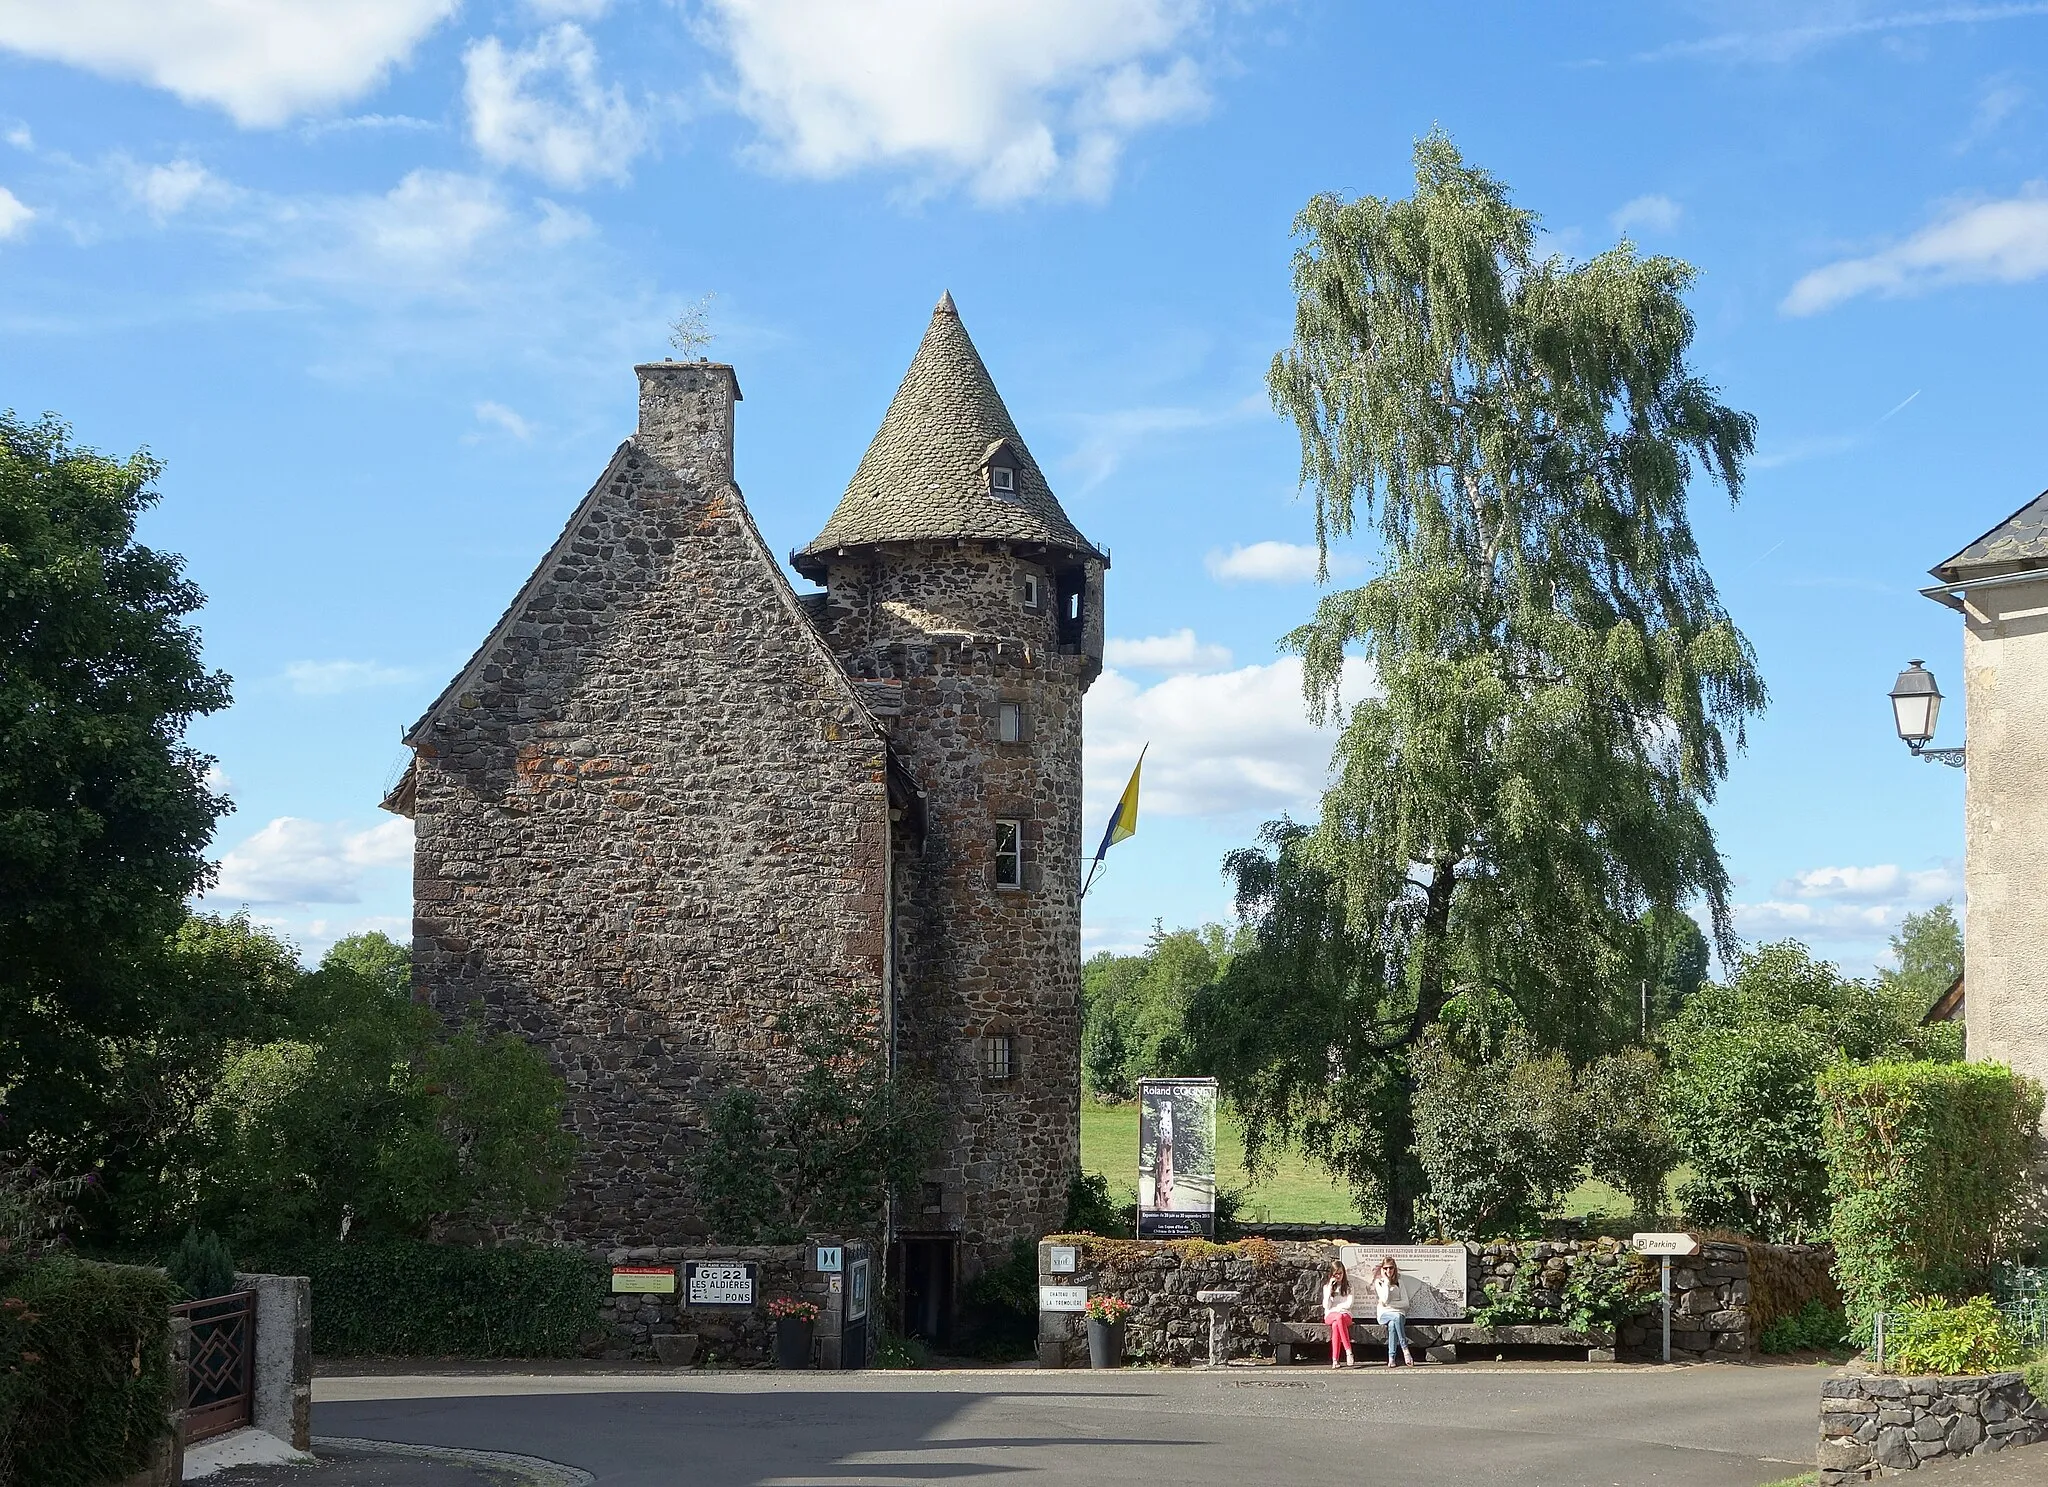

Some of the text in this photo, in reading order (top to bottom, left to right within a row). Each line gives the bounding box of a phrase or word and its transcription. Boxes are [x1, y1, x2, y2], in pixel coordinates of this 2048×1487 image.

[1143, 1086, 1171, 1096] Roland
[1649, 1240, 1677, 1249] Parking
[722, 1270, 741, 1280] 22
[691, 1280, 707, 1289] LES
[725, 1293, 750, 1301] PONS
